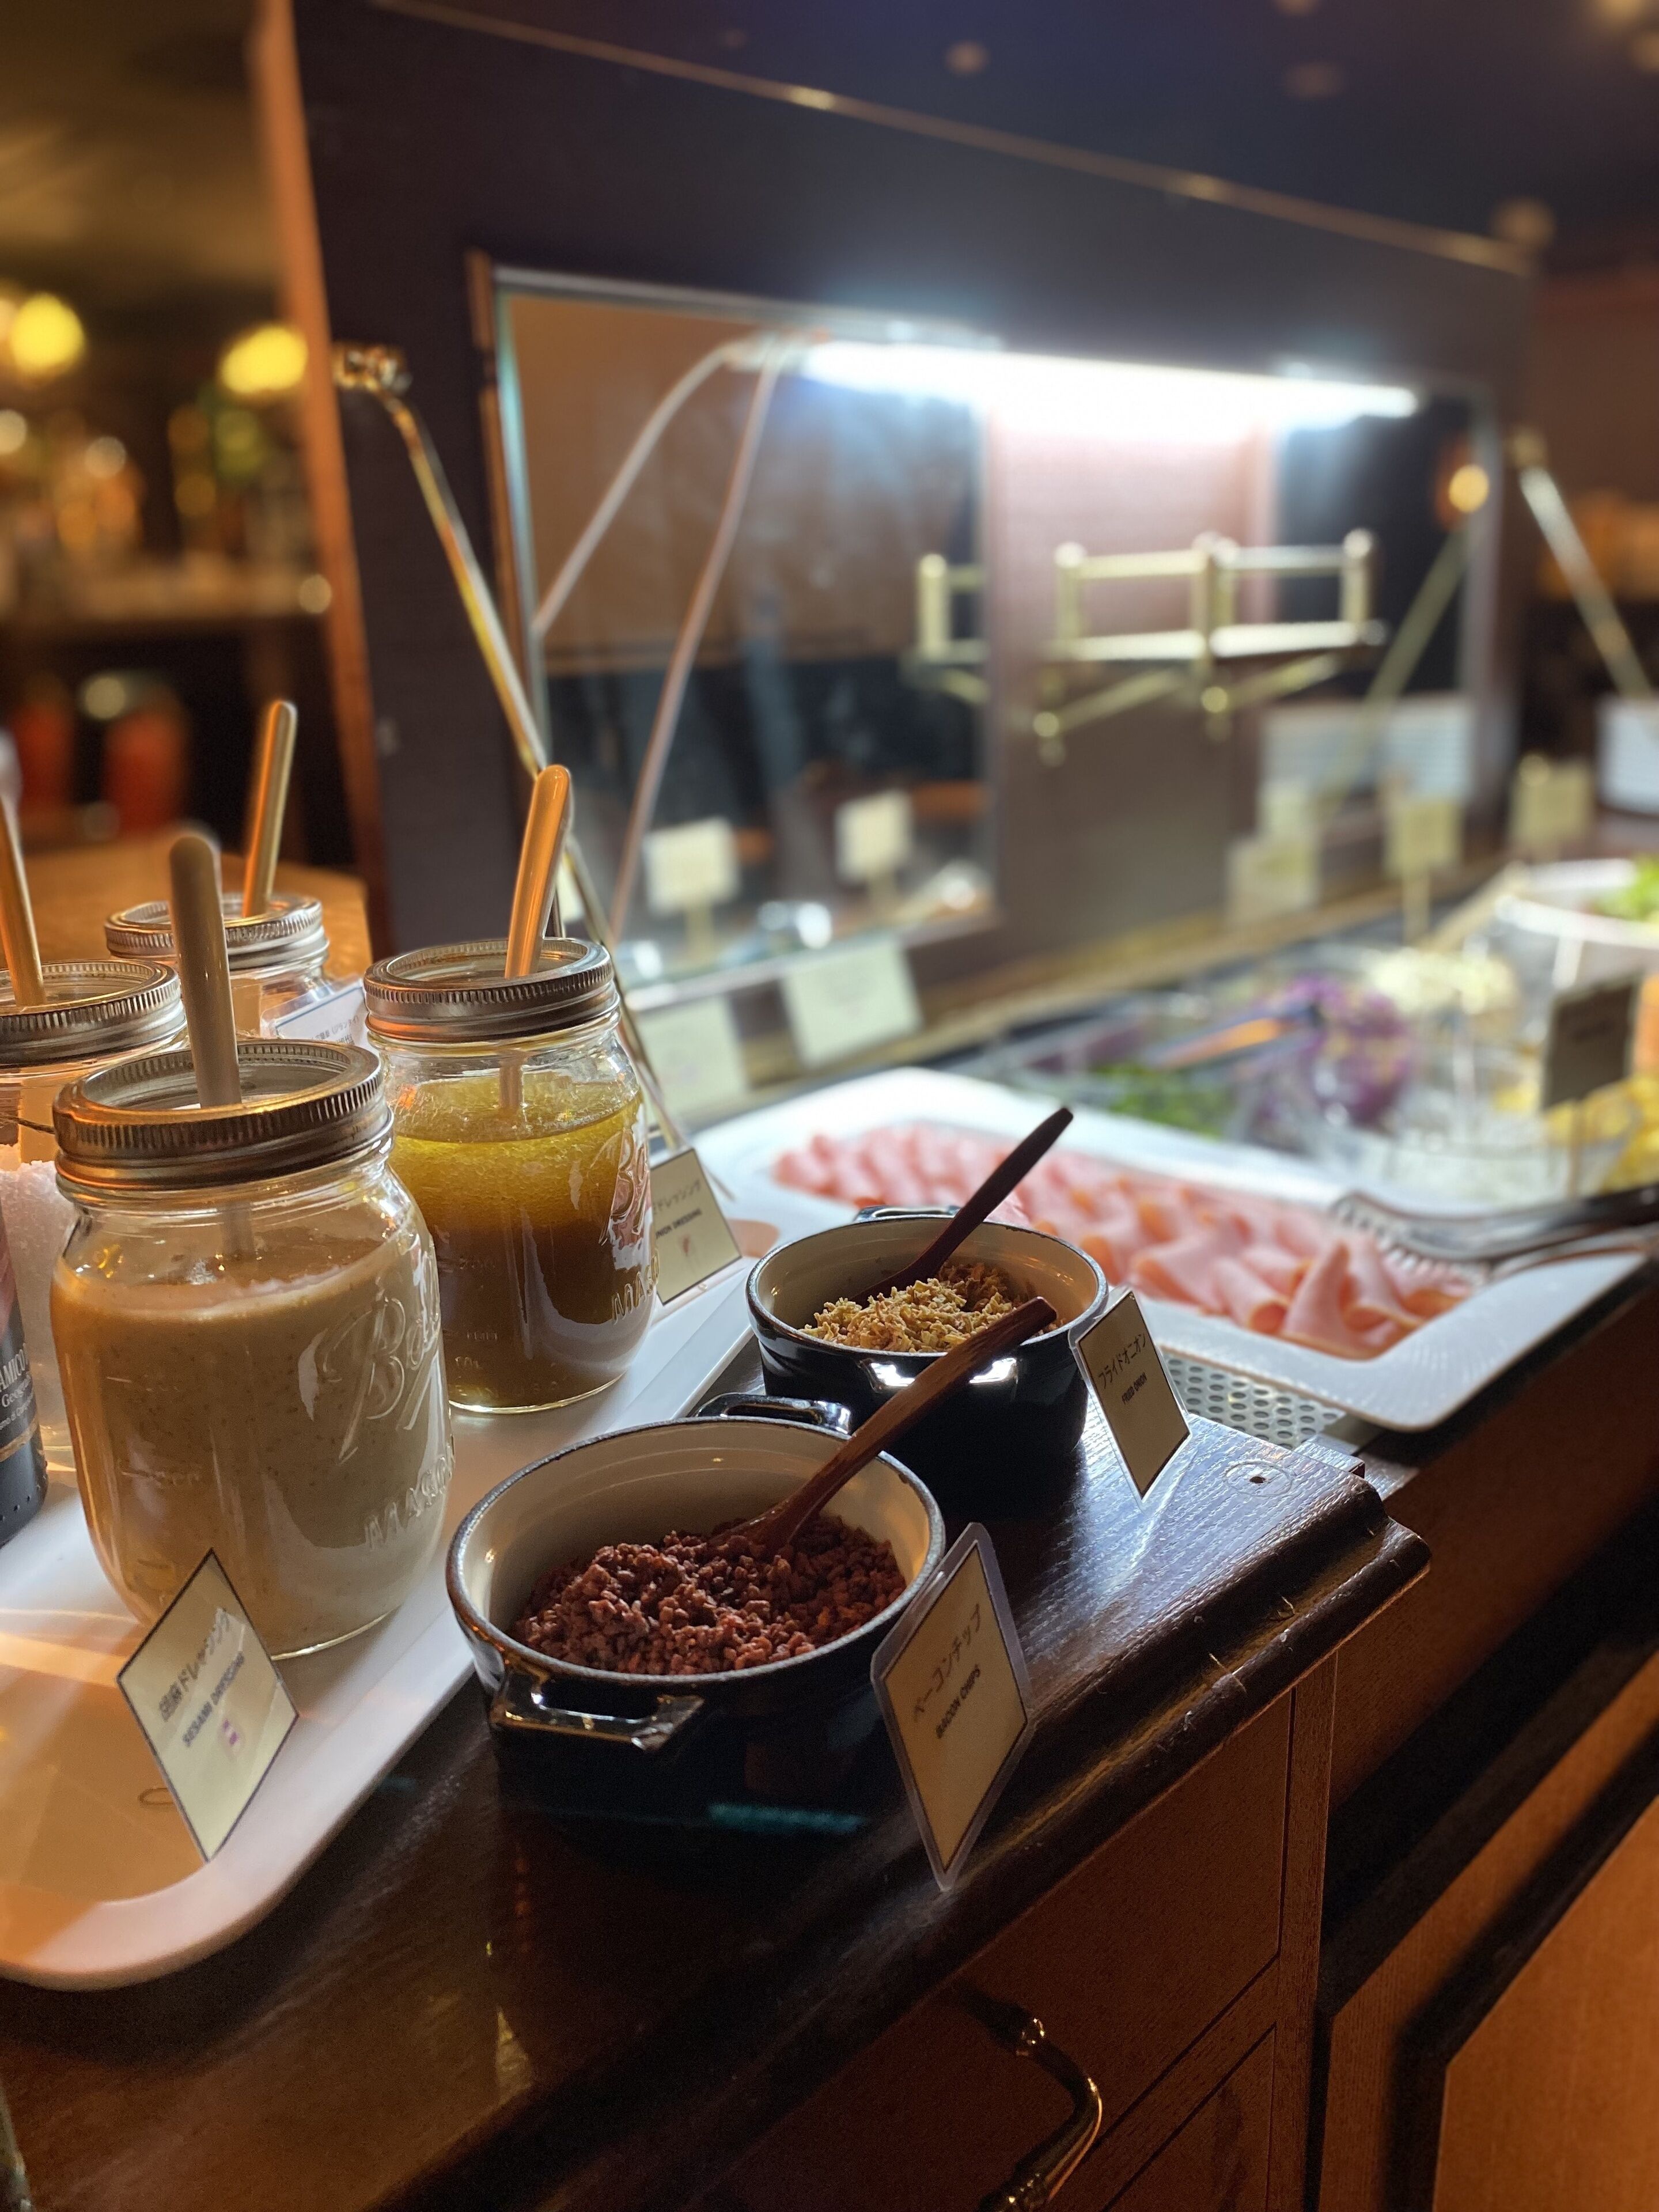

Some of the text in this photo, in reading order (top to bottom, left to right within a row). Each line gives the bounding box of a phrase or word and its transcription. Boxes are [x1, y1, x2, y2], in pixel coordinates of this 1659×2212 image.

[1098, 1334, 1146, 1390] フライドオニオン
[1121, 1372, 1148, 1406] FRIED ONION
[913, 1603, 981, 1722] ベーコンチップ
[935, 1663, 981, 1739] BACON CHIPS
